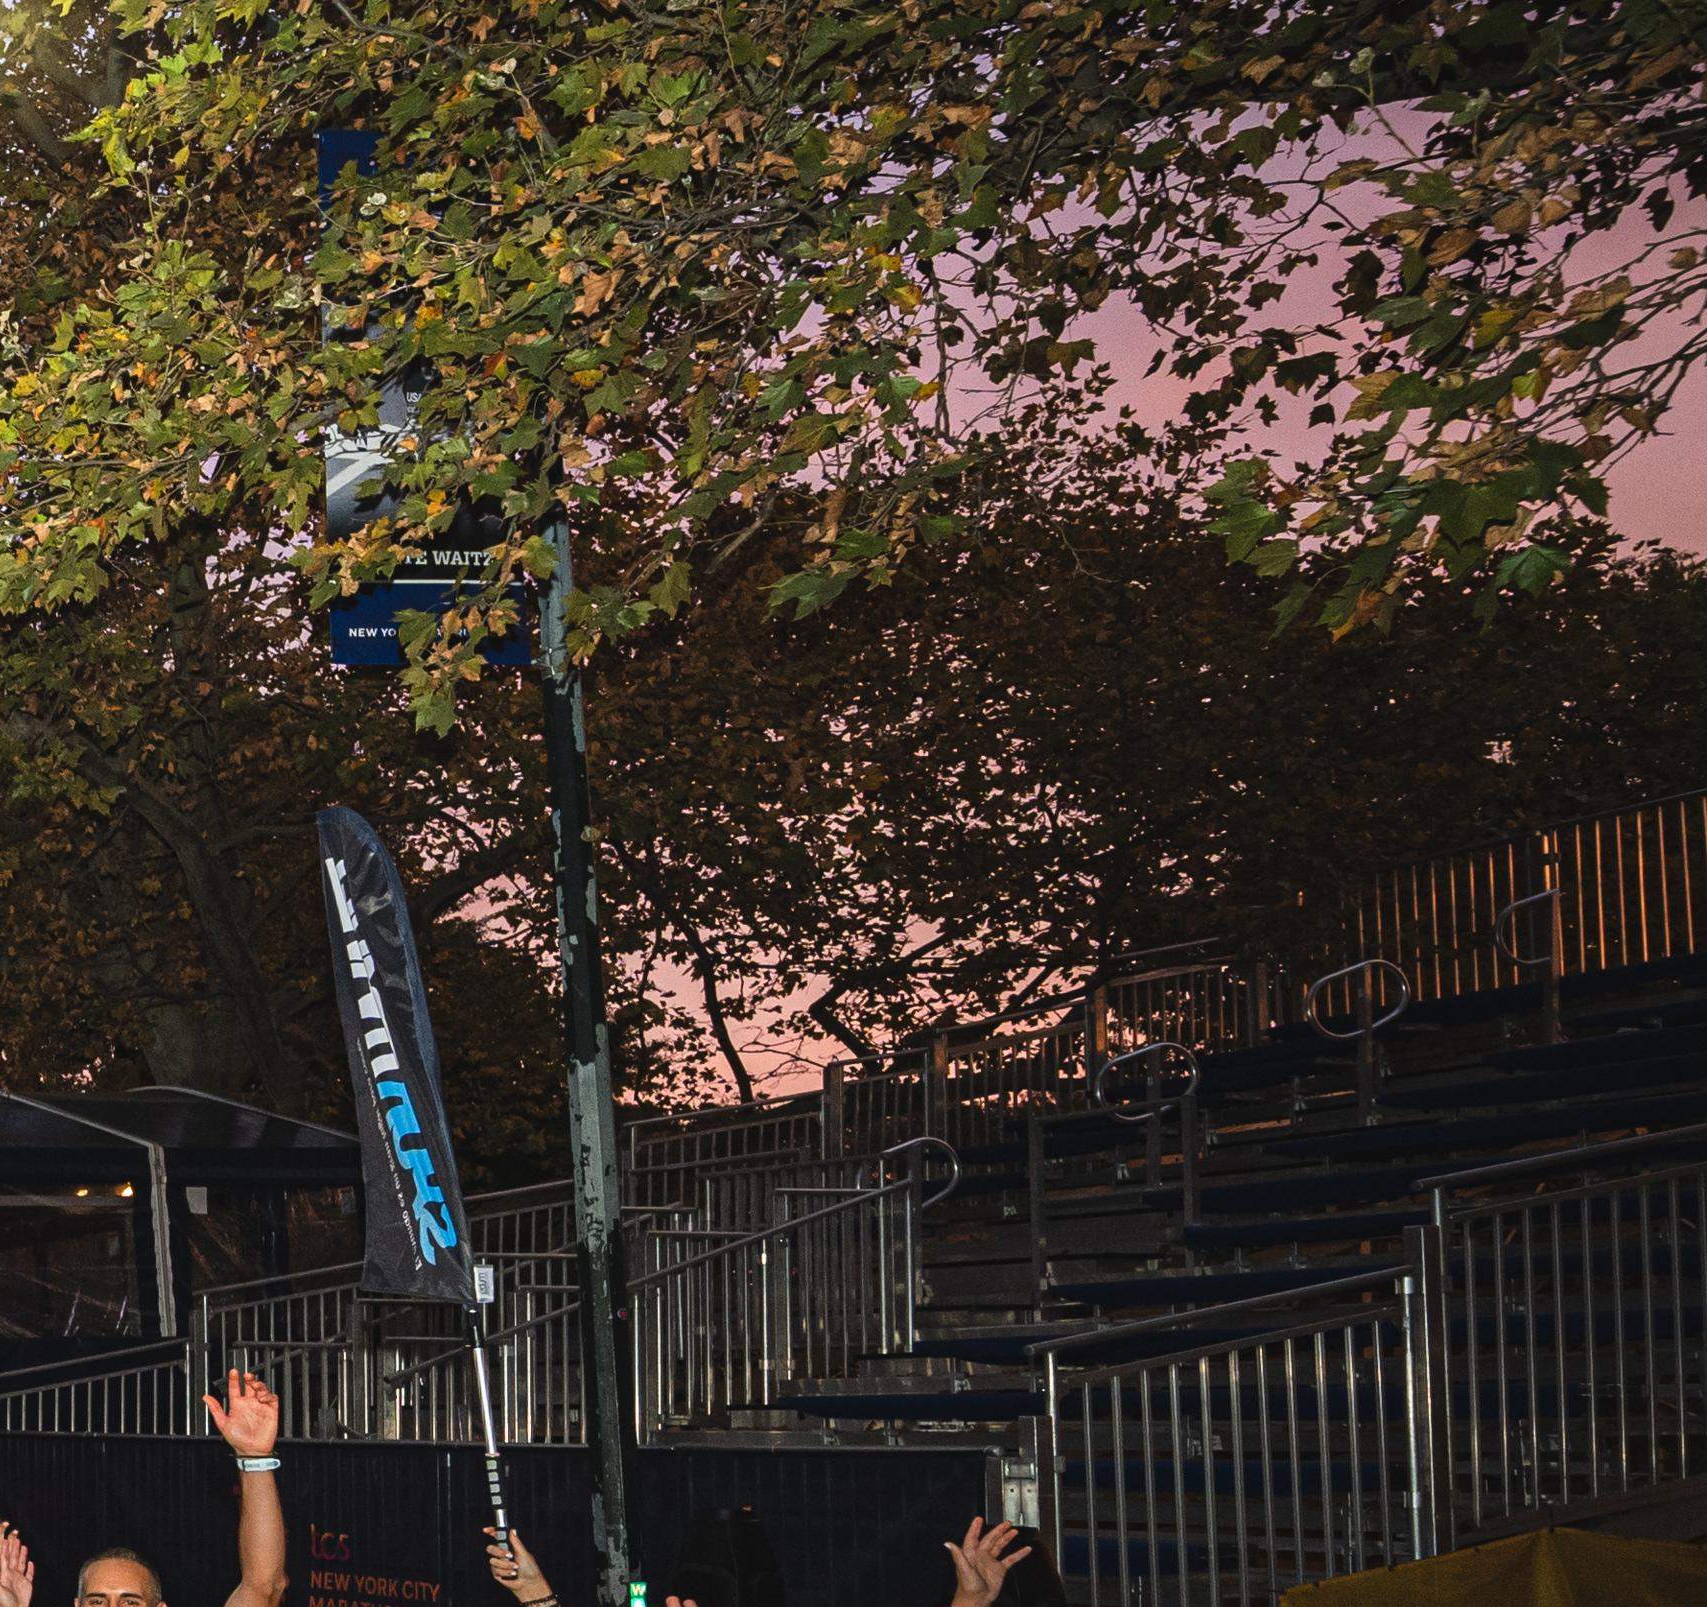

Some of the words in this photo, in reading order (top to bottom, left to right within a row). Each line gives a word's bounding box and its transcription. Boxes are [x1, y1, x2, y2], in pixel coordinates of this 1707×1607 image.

[348, 628, 378, 638] NEW
[309, 1523, 351, 1561] tcs
[310, 1571, 351, 1590] NEW
[355, 1576, 397, 1597] YORK
[402, 1580, 441, 1603] CITY
